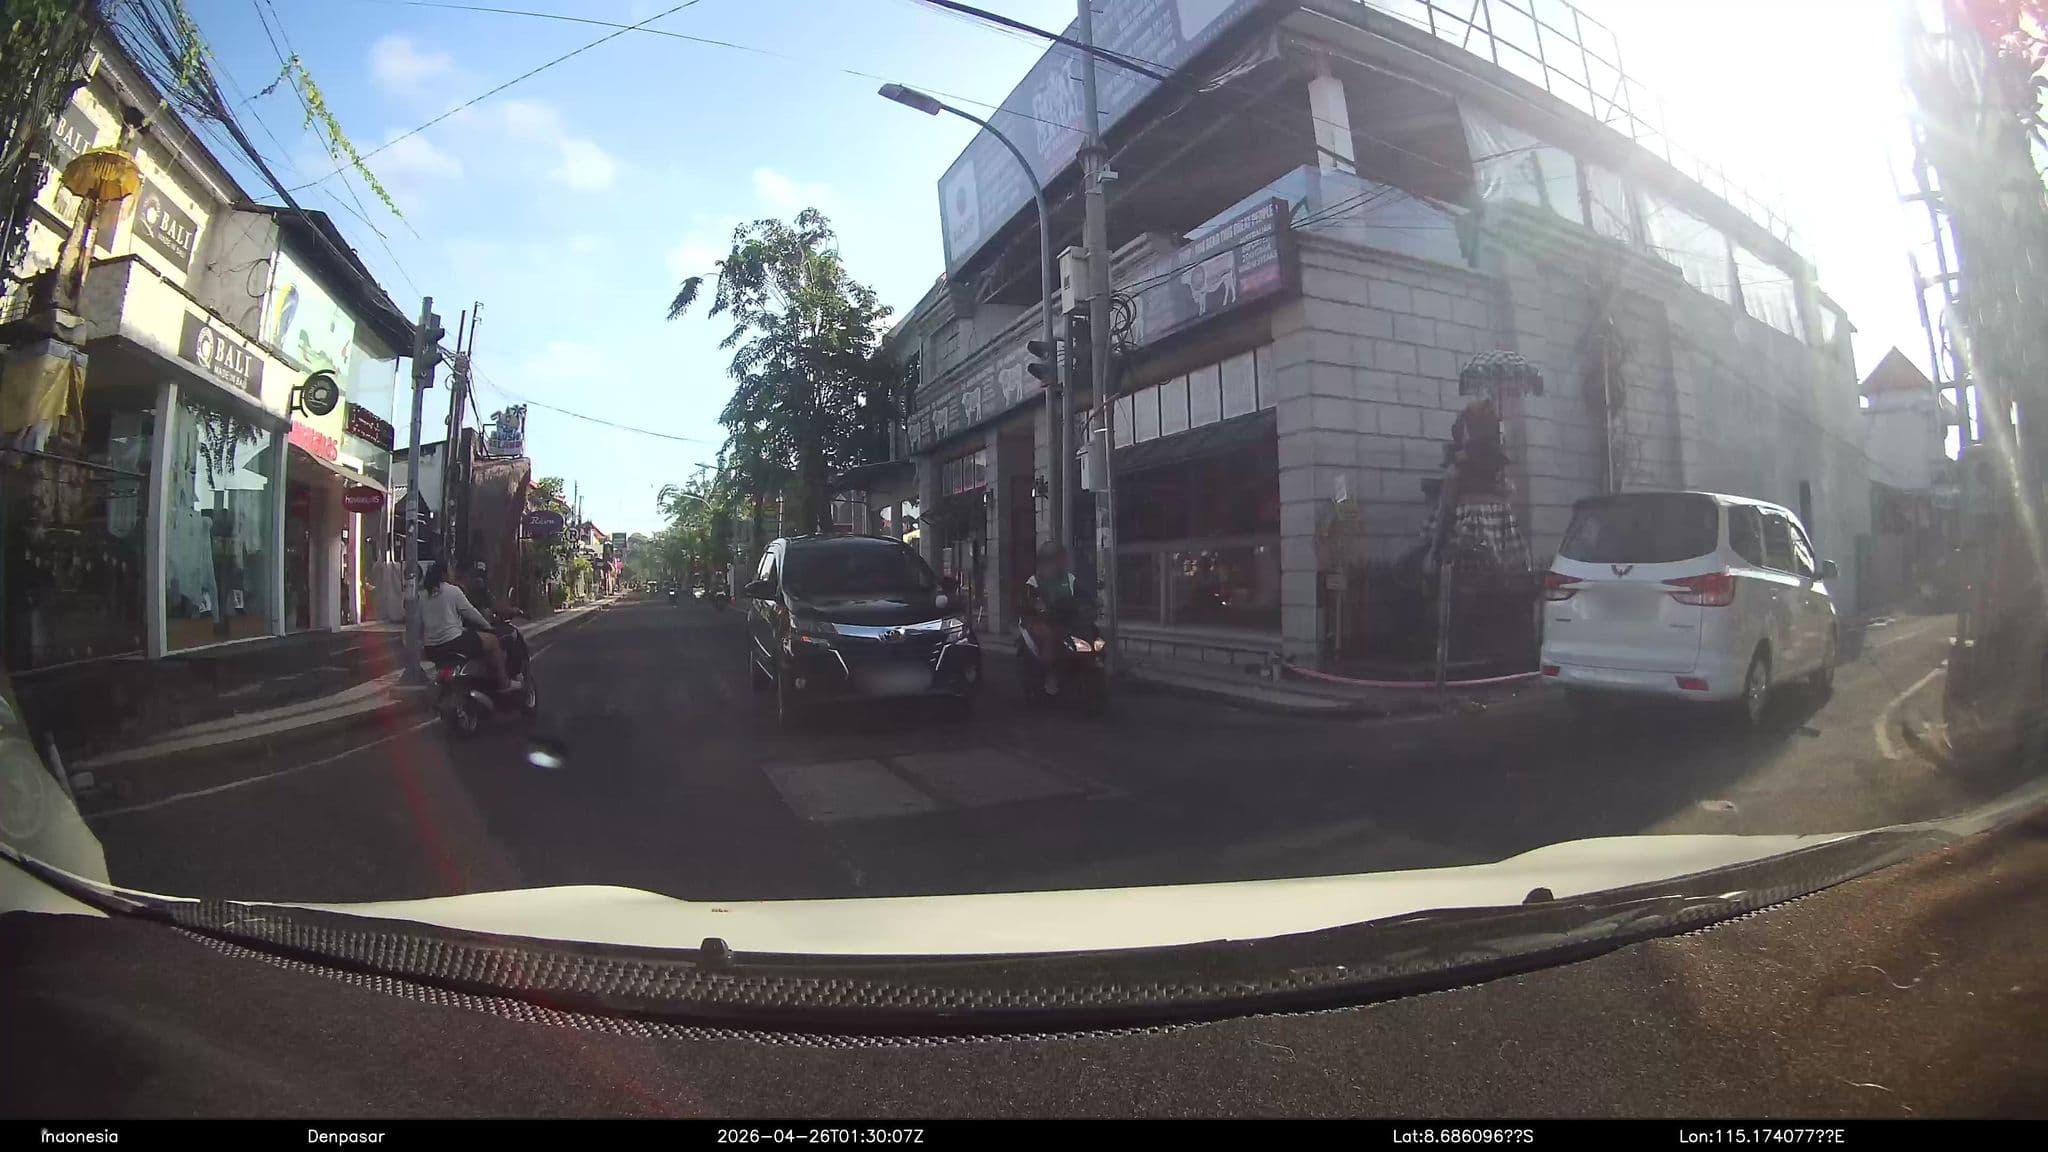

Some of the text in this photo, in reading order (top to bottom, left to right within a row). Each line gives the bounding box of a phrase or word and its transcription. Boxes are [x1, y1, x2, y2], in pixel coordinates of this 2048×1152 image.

[55, 115, 91, 155] BALI
[159, 211, 192, 250] BALI
[215, 337, 252, 378] BALI
